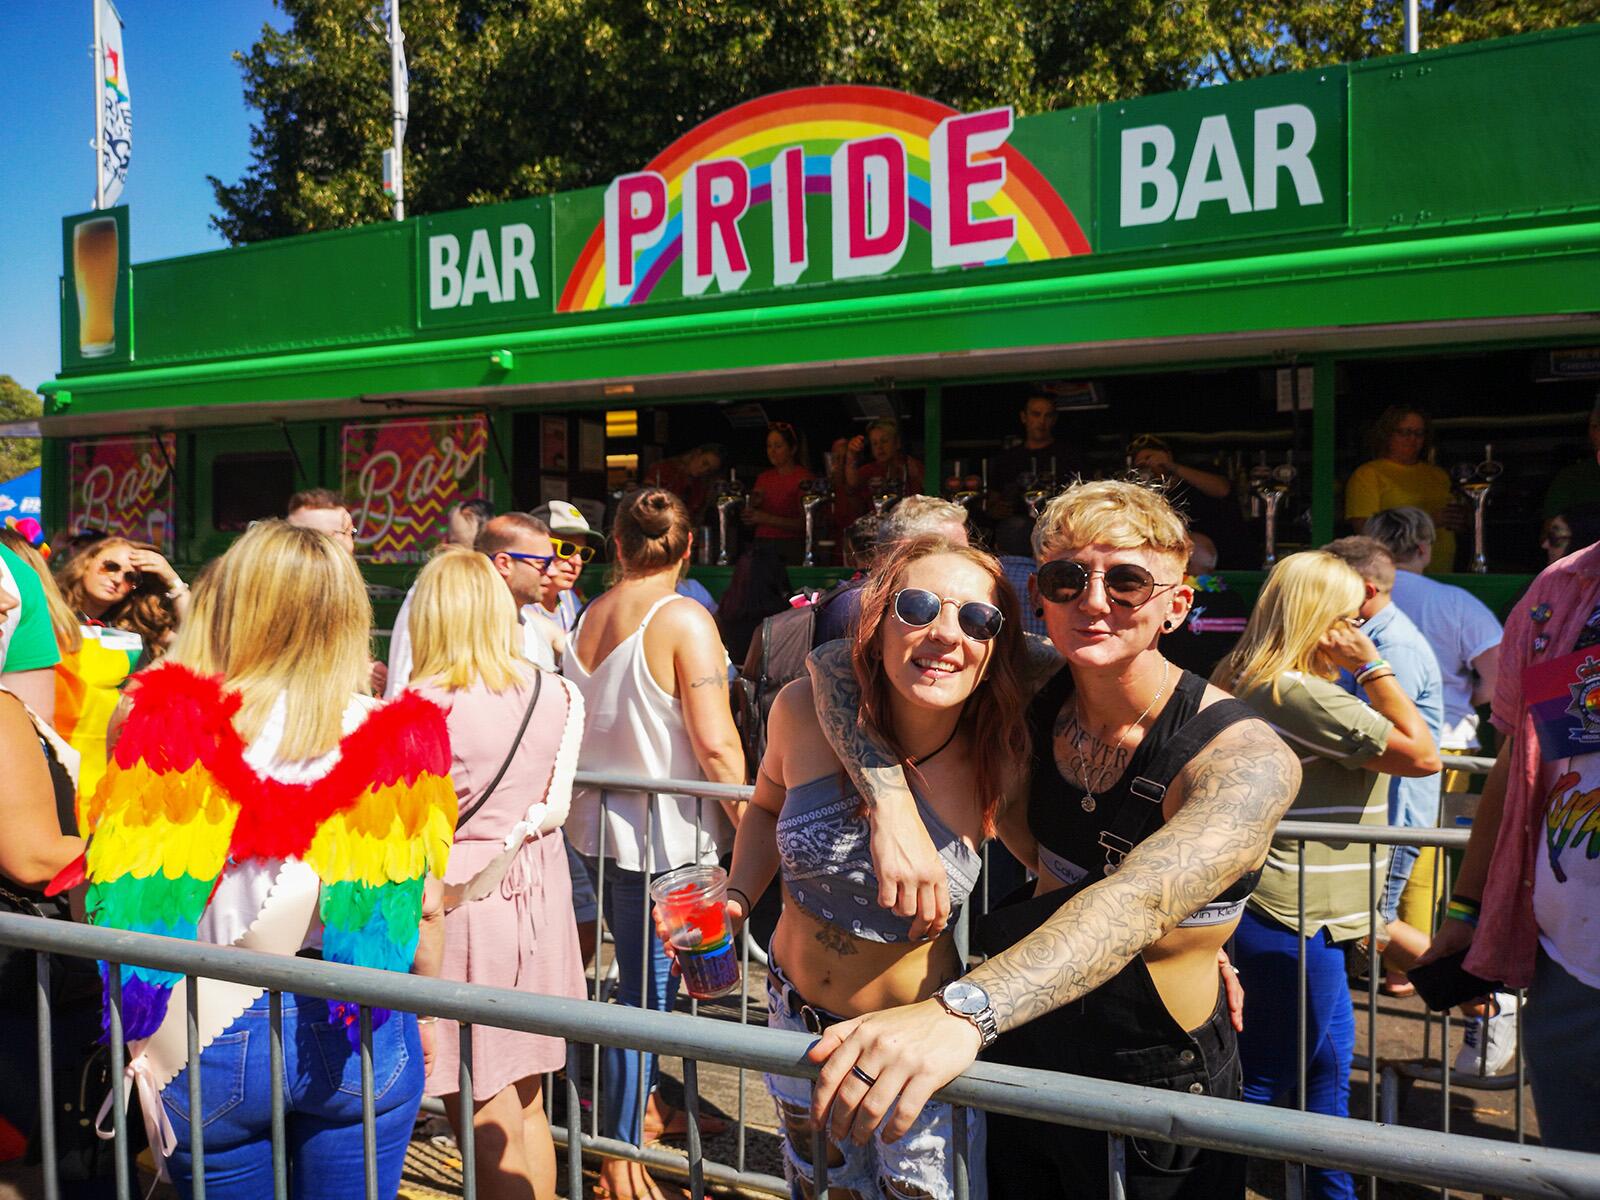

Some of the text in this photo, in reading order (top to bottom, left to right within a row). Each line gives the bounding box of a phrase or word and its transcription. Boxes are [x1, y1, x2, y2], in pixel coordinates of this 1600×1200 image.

[604, 106, 1016, 305] PRIDE
[1120, 103, 1325, 228] BAR
[429, 222, 540, 310] BAR
[75, 453, 168, 537] Bar
[351, 437, 475, 544] Bar
